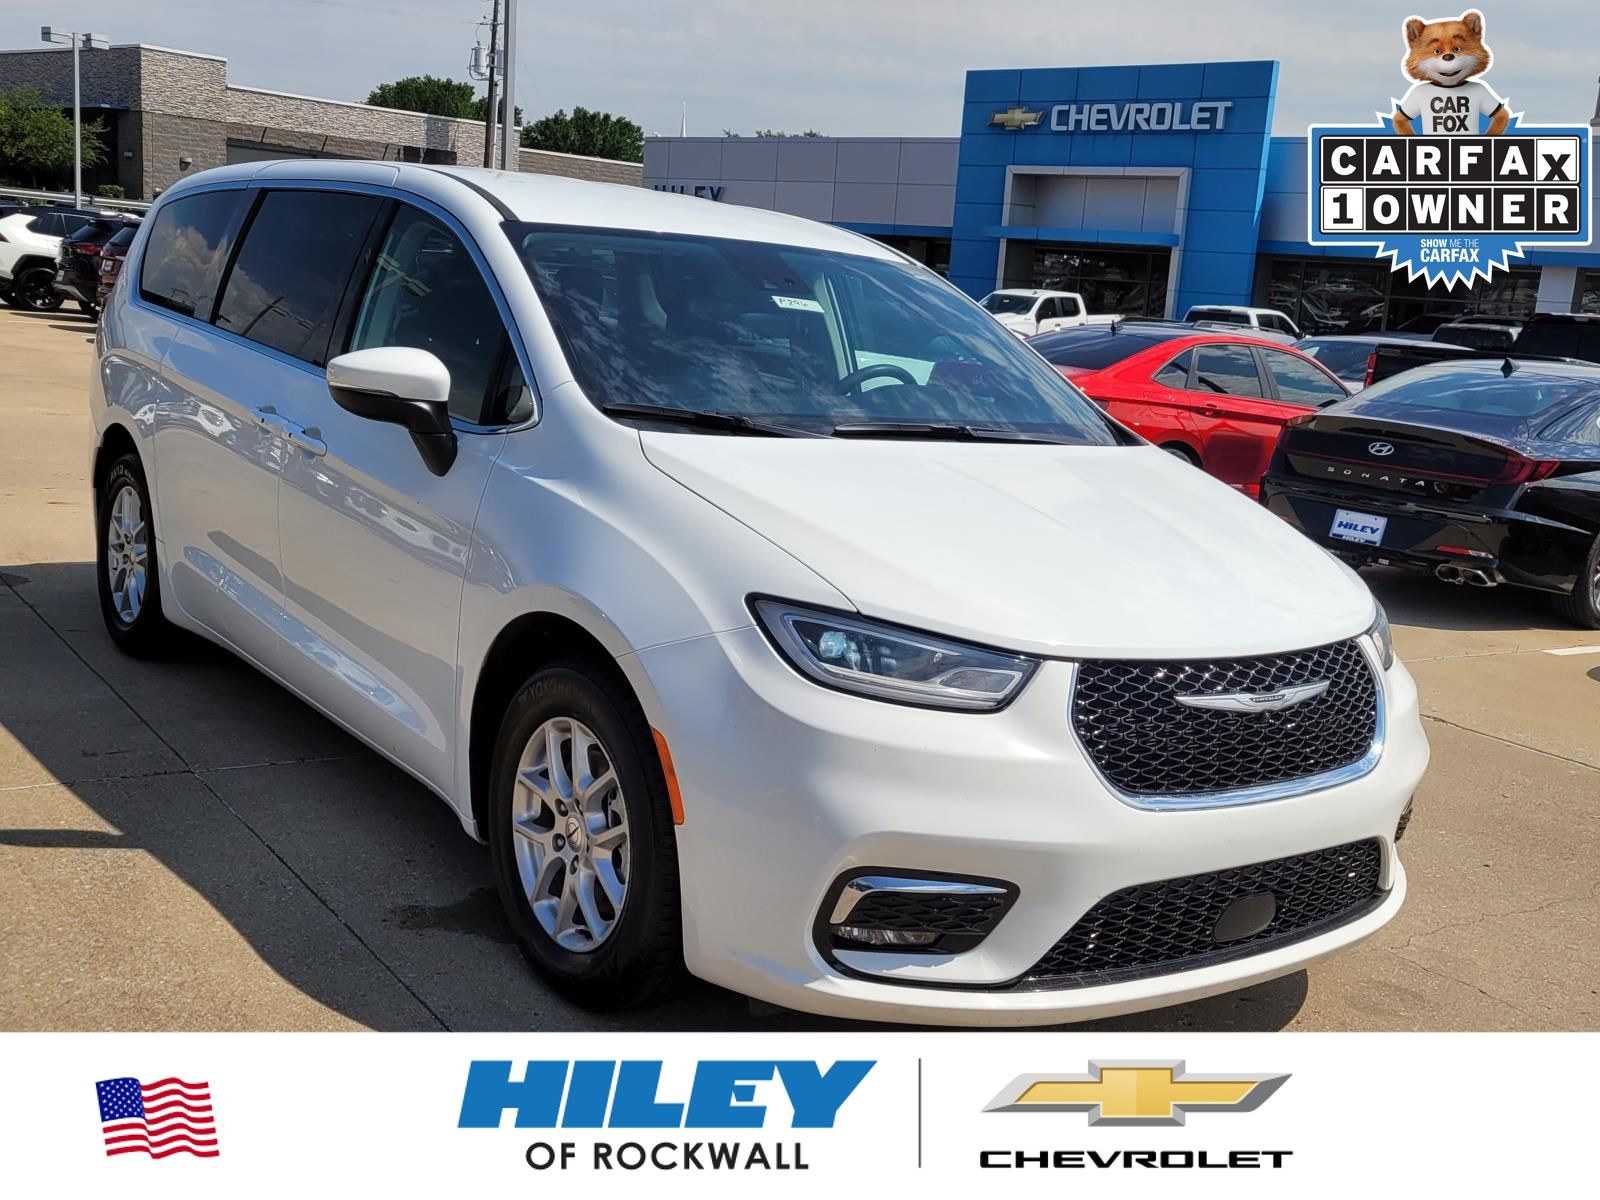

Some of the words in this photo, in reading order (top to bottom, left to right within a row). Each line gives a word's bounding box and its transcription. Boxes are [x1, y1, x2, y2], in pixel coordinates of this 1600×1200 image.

[1050, 101, 1232, 132] CHEVROLET
[1327, 466, 1425, 486] SONATA
[1337, 521, 1380, 534] HILEY
